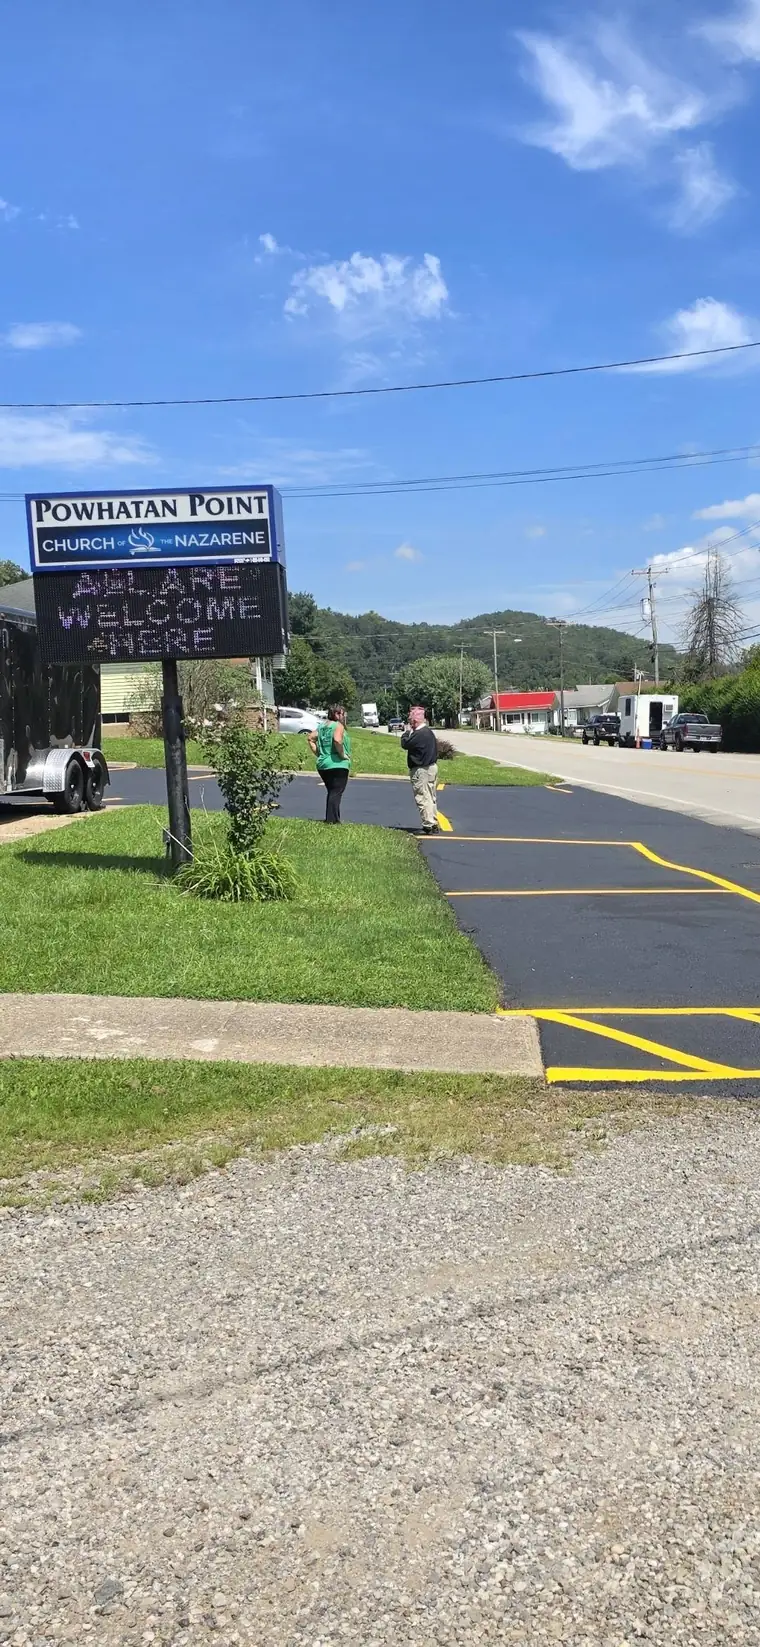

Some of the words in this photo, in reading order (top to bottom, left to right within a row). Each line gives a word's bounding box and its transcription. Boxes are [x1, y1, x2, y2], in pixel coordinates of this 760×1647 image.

[35, 498, 178, 523] POWHATAN
[188, 494, 267, 517] POINT
[42, 537, 115, 552] CHURCH
[174, 531, 266, 547] NAZARENE
[159, 566, 242, 596] ARE
[57, 596, 262, 630] WELCOME
